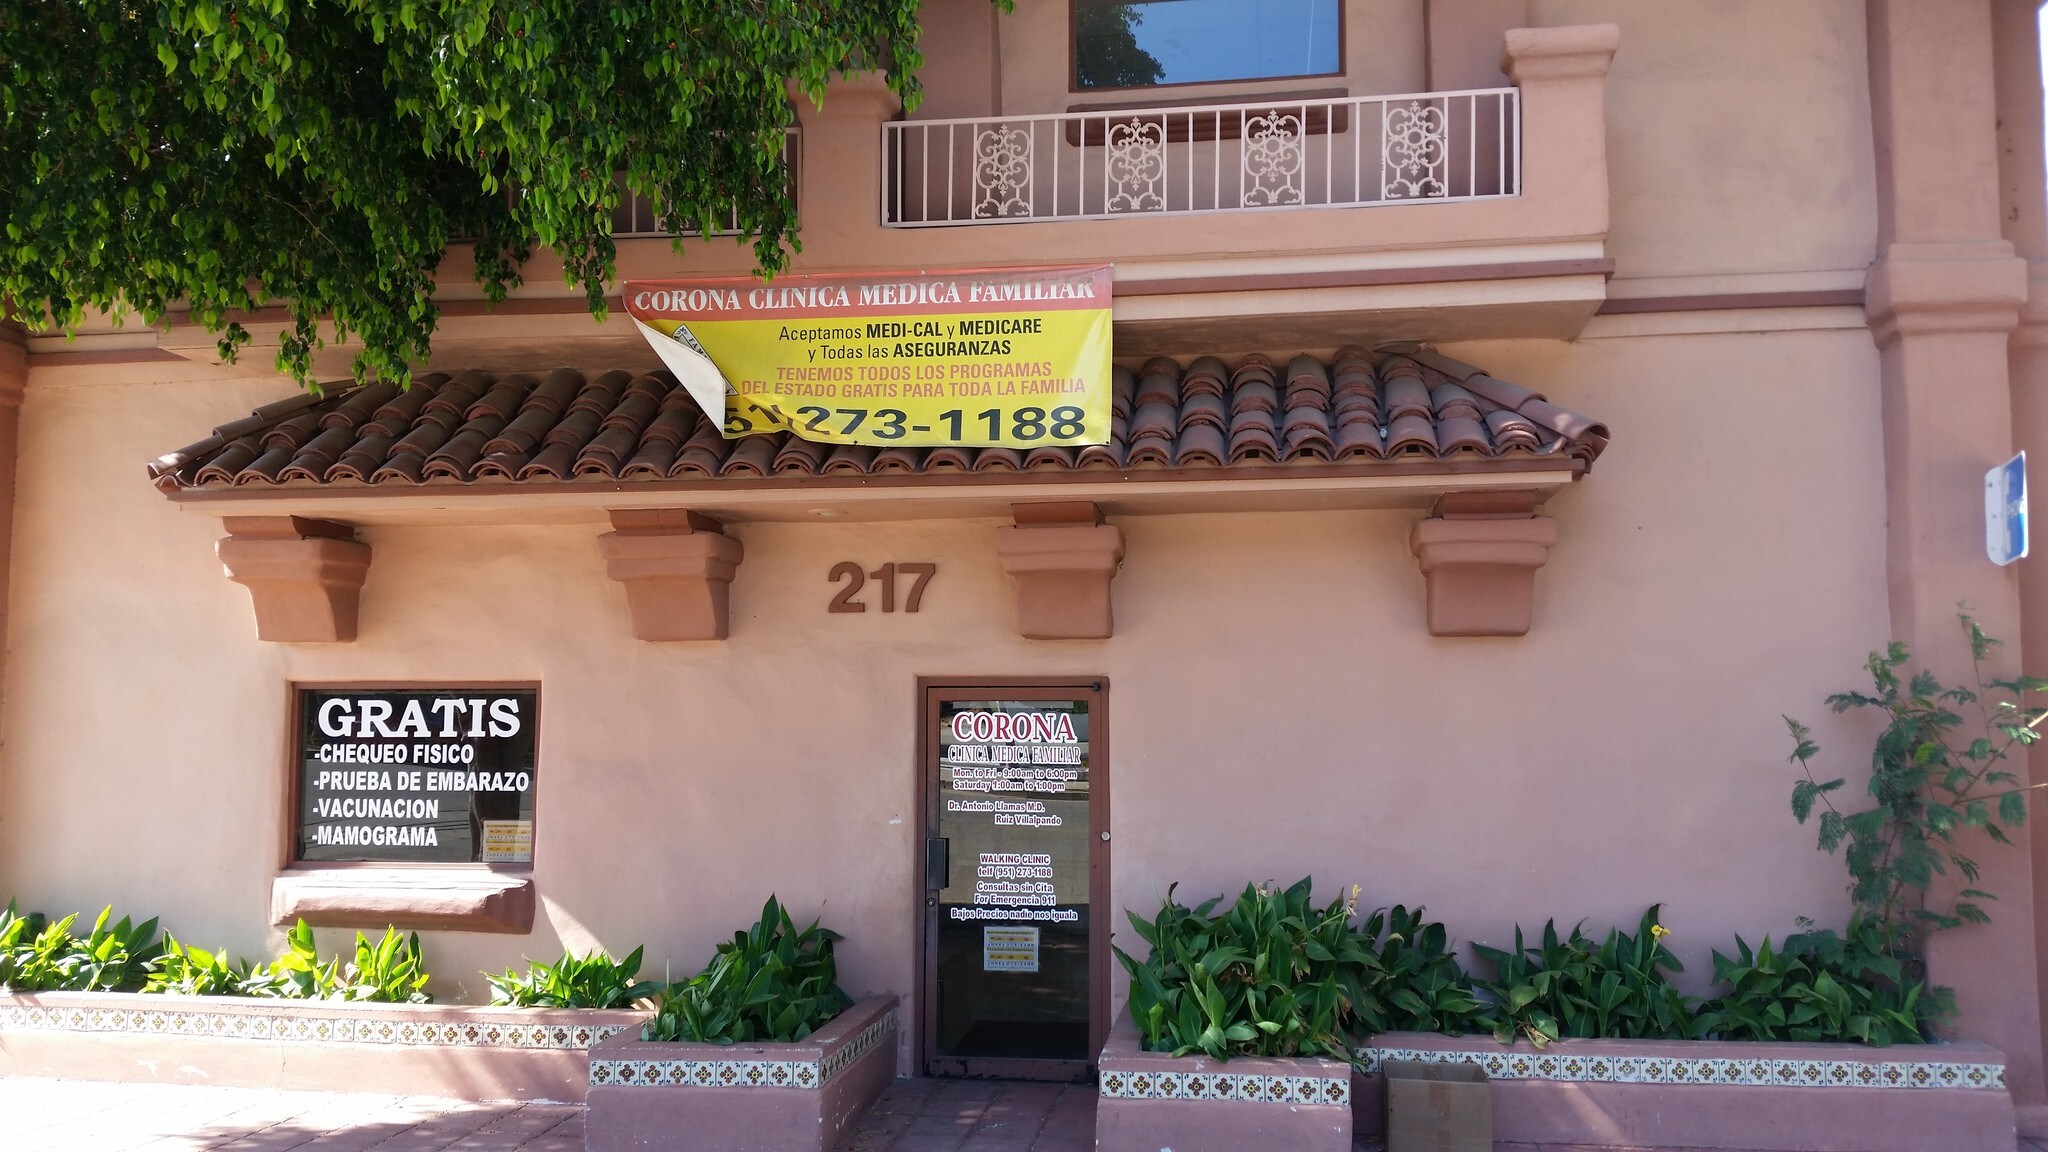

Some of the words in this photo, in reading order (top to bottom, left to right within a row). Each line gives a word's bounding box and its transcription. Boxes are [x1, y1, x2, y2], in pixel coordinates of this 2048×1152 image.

[634, 288, 742, 313] CORONA
[749, 285, 850, 309] CLINICA
[858, 281, 961, 306] MEDICA
[968, 276, 1095, 302] FAMILIAR
[779, 325, 862, 343] Aceptamos
[866, 322, 942, 339] MEDI-CAL
[946, 325, 955, 339] y
[959, 319, 1042, 336] MEDICARE
[808, 349, 816, 362] y
[820, 344, 863, 360] Todas
[868, 343, 889, 358] las
[893, 340, 1011, 358] ASEGURANZAS
[776, 367, 853, 381] TENEMOS
[858, 365, 911, 381] TODOS
[916, 365, 945, 380] LOS
[950, 362, 1052, 379] PROGRAMAS
[741, 380, 770, 395] DEL
[774, 382, 837, 398] ESTADO
[841, 383, 898, 398] GRATIS
[903, 383, 945, 397] PARA
[950, 381, 992, 397] TODA
[997, 380, 1016, 396] LA
[1021, 378, 1086, 395] FAMILIA
[796, 405, 1086, 441] 273-1188
[828, 561, 936, 613] 217
[318, 698, 521, 738] GRATIS
[953, 712, 1077, 743] CORONA
[314, 743, 408, 764] -CHEQUEO
[413, 744, 474, 763] FISICO
[949, 745, 989, 763] CLINICA
[991, 746, 1030, 763] MEDICA
[1031, 747, 1081, 764] FAMILIAR
[313, 771, 392, 791] -PRUEBA
[397, 771, 421, 791] DE
[426, 771, 529, 792] EMBARAZO
[953, 768, 973, 778] Mon.
[974, 768, 984, 778] to
[985, 768, 997, 778] Fri
[1003, 769, 1034, 779] 9:00am
[1035, 769, 1045, 779] to
[1046, 769, 1077, 781] 6:00pm
[953, 781, 991, 792] Saturday
[1024, 781, 1034, 791] to
[1035, 781, 1065, 793] 1:00pm
[312, 798, 439, 819] -VACUNACION
[948, 801, 960, 811] Dr.
[962, 801, 994, 811] Antonio
[995, 801, 1025, 812] Llamas
[1026, 802, 1045, 812] M.D.
[995, 814, 1014, 825] Ruiz
[1014, 814, 1062, 827] Villalpando
[311, 825, 438, 846] -MAMOGRAMA
[980, 854, 1020, 865] WALKING
[1021, 854, 1051, 865] CLINIC
[978, 866, 993, 877] telf
[994, 867, 1016, 879] (951)
[1017, 867, 1052, 877] 273-1188
[977, 882, 1019, 892] Consultas
[1020, 882, 1033, 893] sin
[1034, 882, 1053, 893] Cita
[974, 894, 988, 905] For
[990, 895, 1040, 907] Emergencia
[1041, 895, 1056, 906] 911
[951, 908, 975, 920] Bajos
[976, 908, 1008, 919] Precios
[1009, 909, 1033, 919] nadie
[1034, 911, 1050, 920] nos
[1051, 909, 1078, 922] iguala
